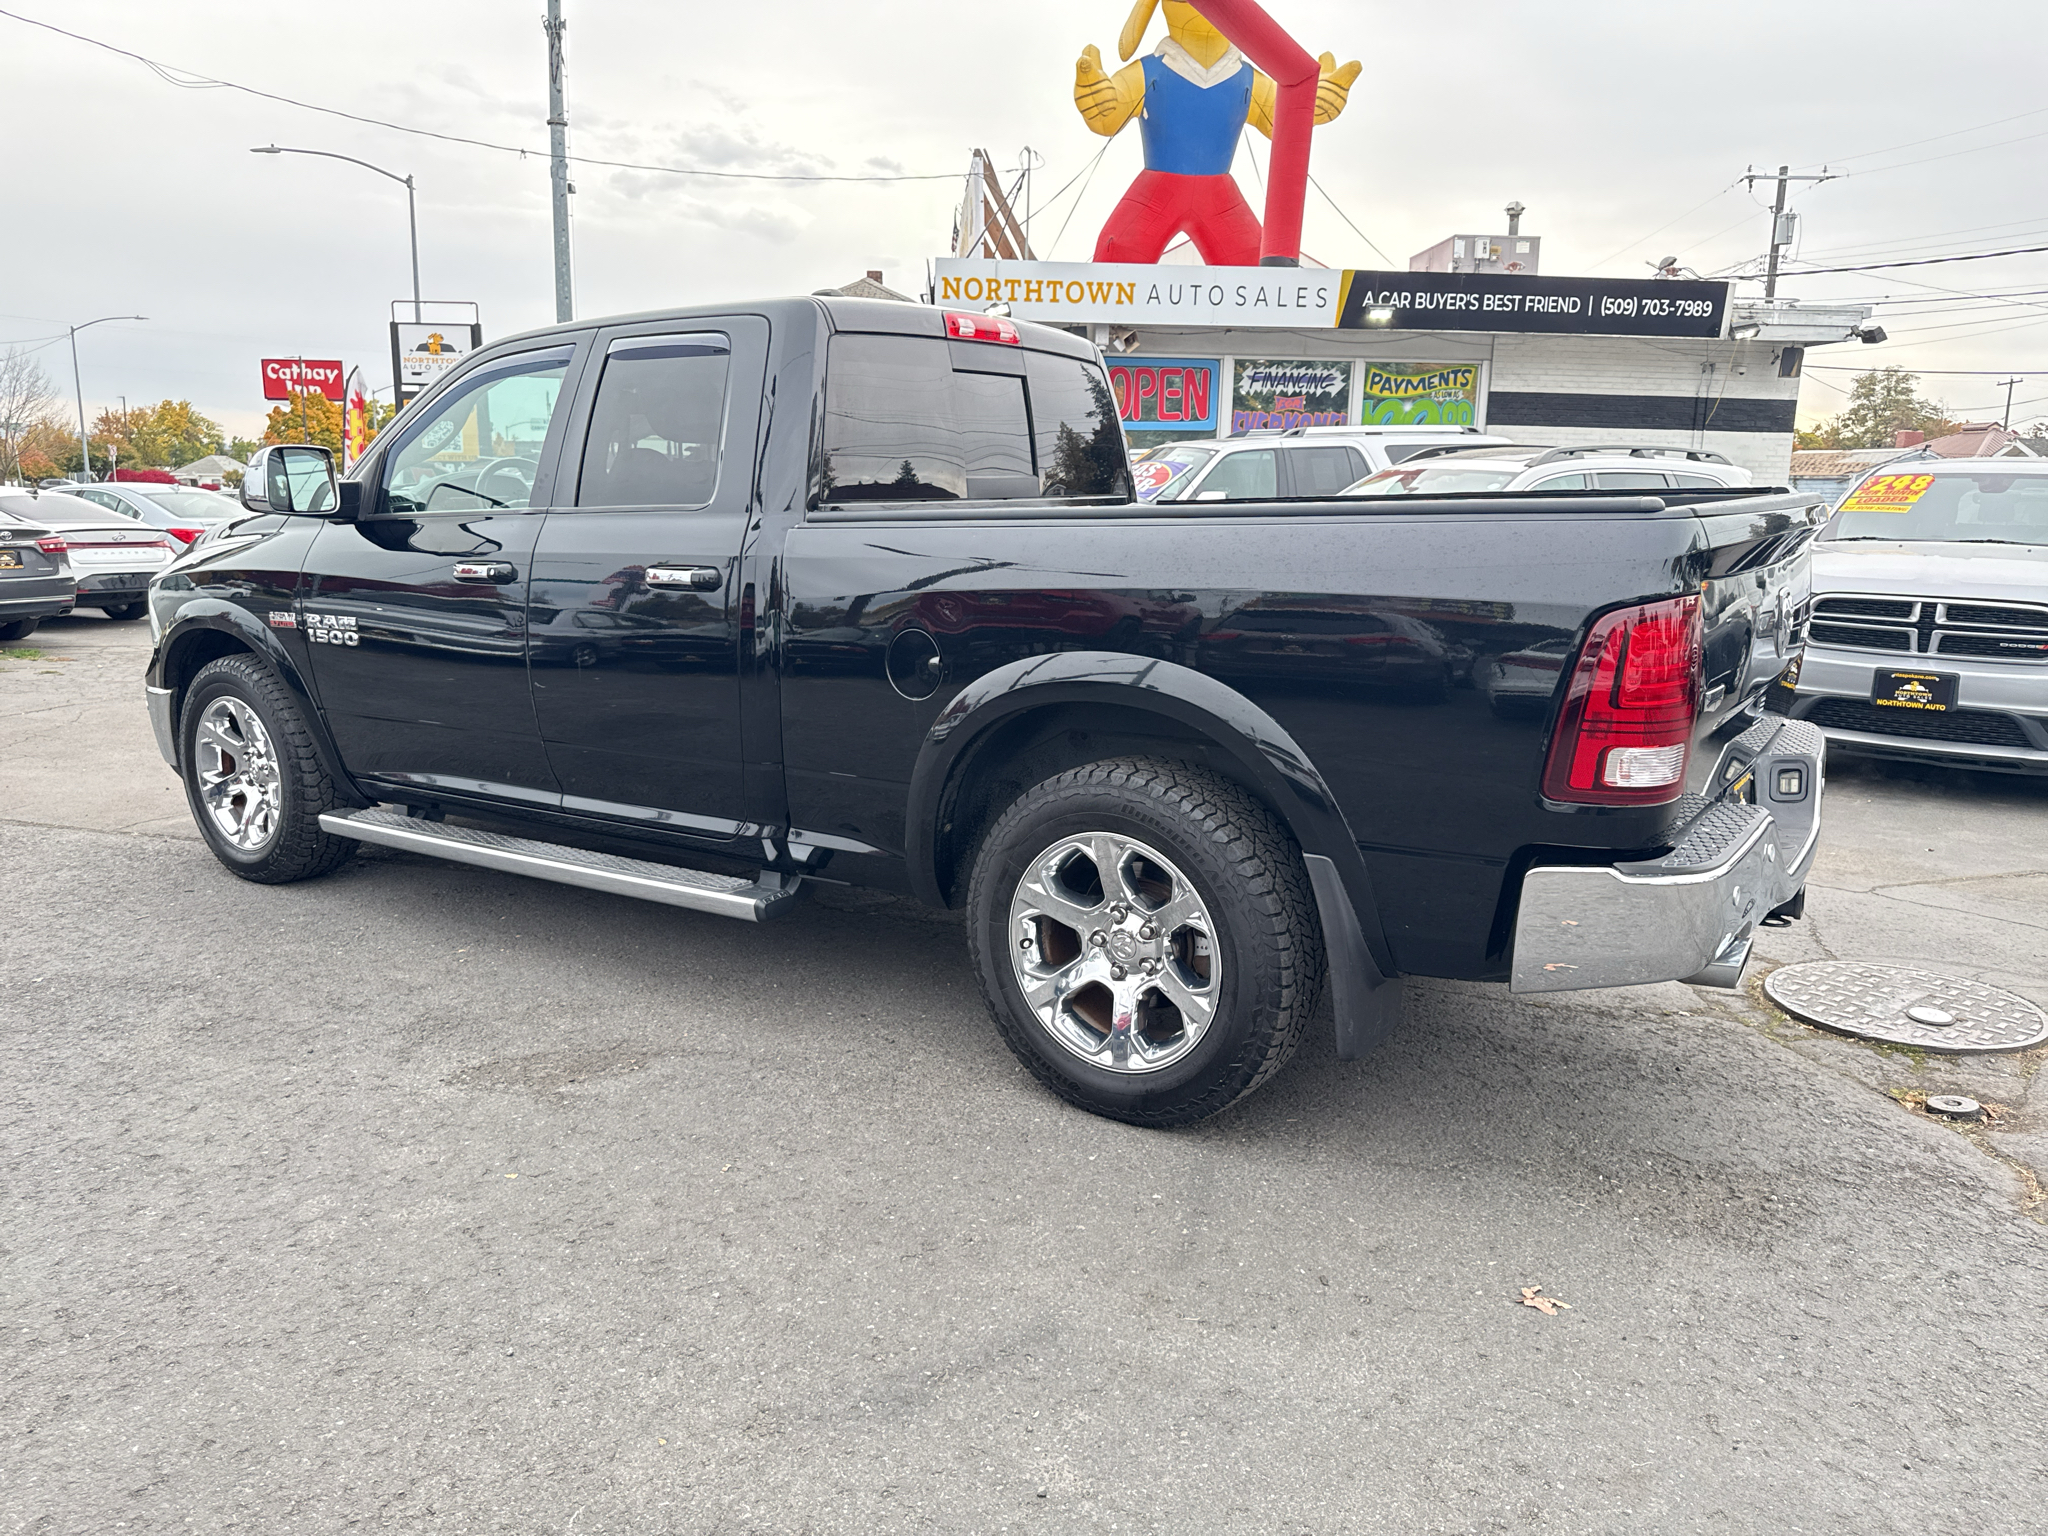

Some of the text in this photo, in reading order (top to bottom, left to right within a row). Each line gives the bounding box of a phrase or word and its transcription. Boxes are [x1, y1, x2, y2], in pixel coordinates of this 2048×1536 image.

[941, 276, 1328, 308] NORTHTOWN AUTO SALES
[1362, 290, 1375, 307] A
[1378, 291, 1411, 309] CAR
[1414, 292, 1479, 311] BUYER'S
[1483, 294, 1522, 312] BEST
[1525, 296, 1581, 314] FRIEND
[1600, 296, 1638, 316] (509)
[1641, 298, 1713, 317] 703-7989
[266, 363, 339, 384] Cathay
[1249, 371, 1336, 390] FINANCING
[1369, 368, 1472, 395] PAYMENTS
[285, 380, 321, 395] Inn
[1110, 366, 1210, 421] OPEN
[1276, 399, 1301, 411] FOR
[1863, 475, 1934, 491] $248
[1856, 496, 1909, 504] LOADED
[303, 613, 358, 630] RAM
[307, 628, 359, 647] 1500
[1876, 698, 1946, 712] NORTHTOWN AUTO
